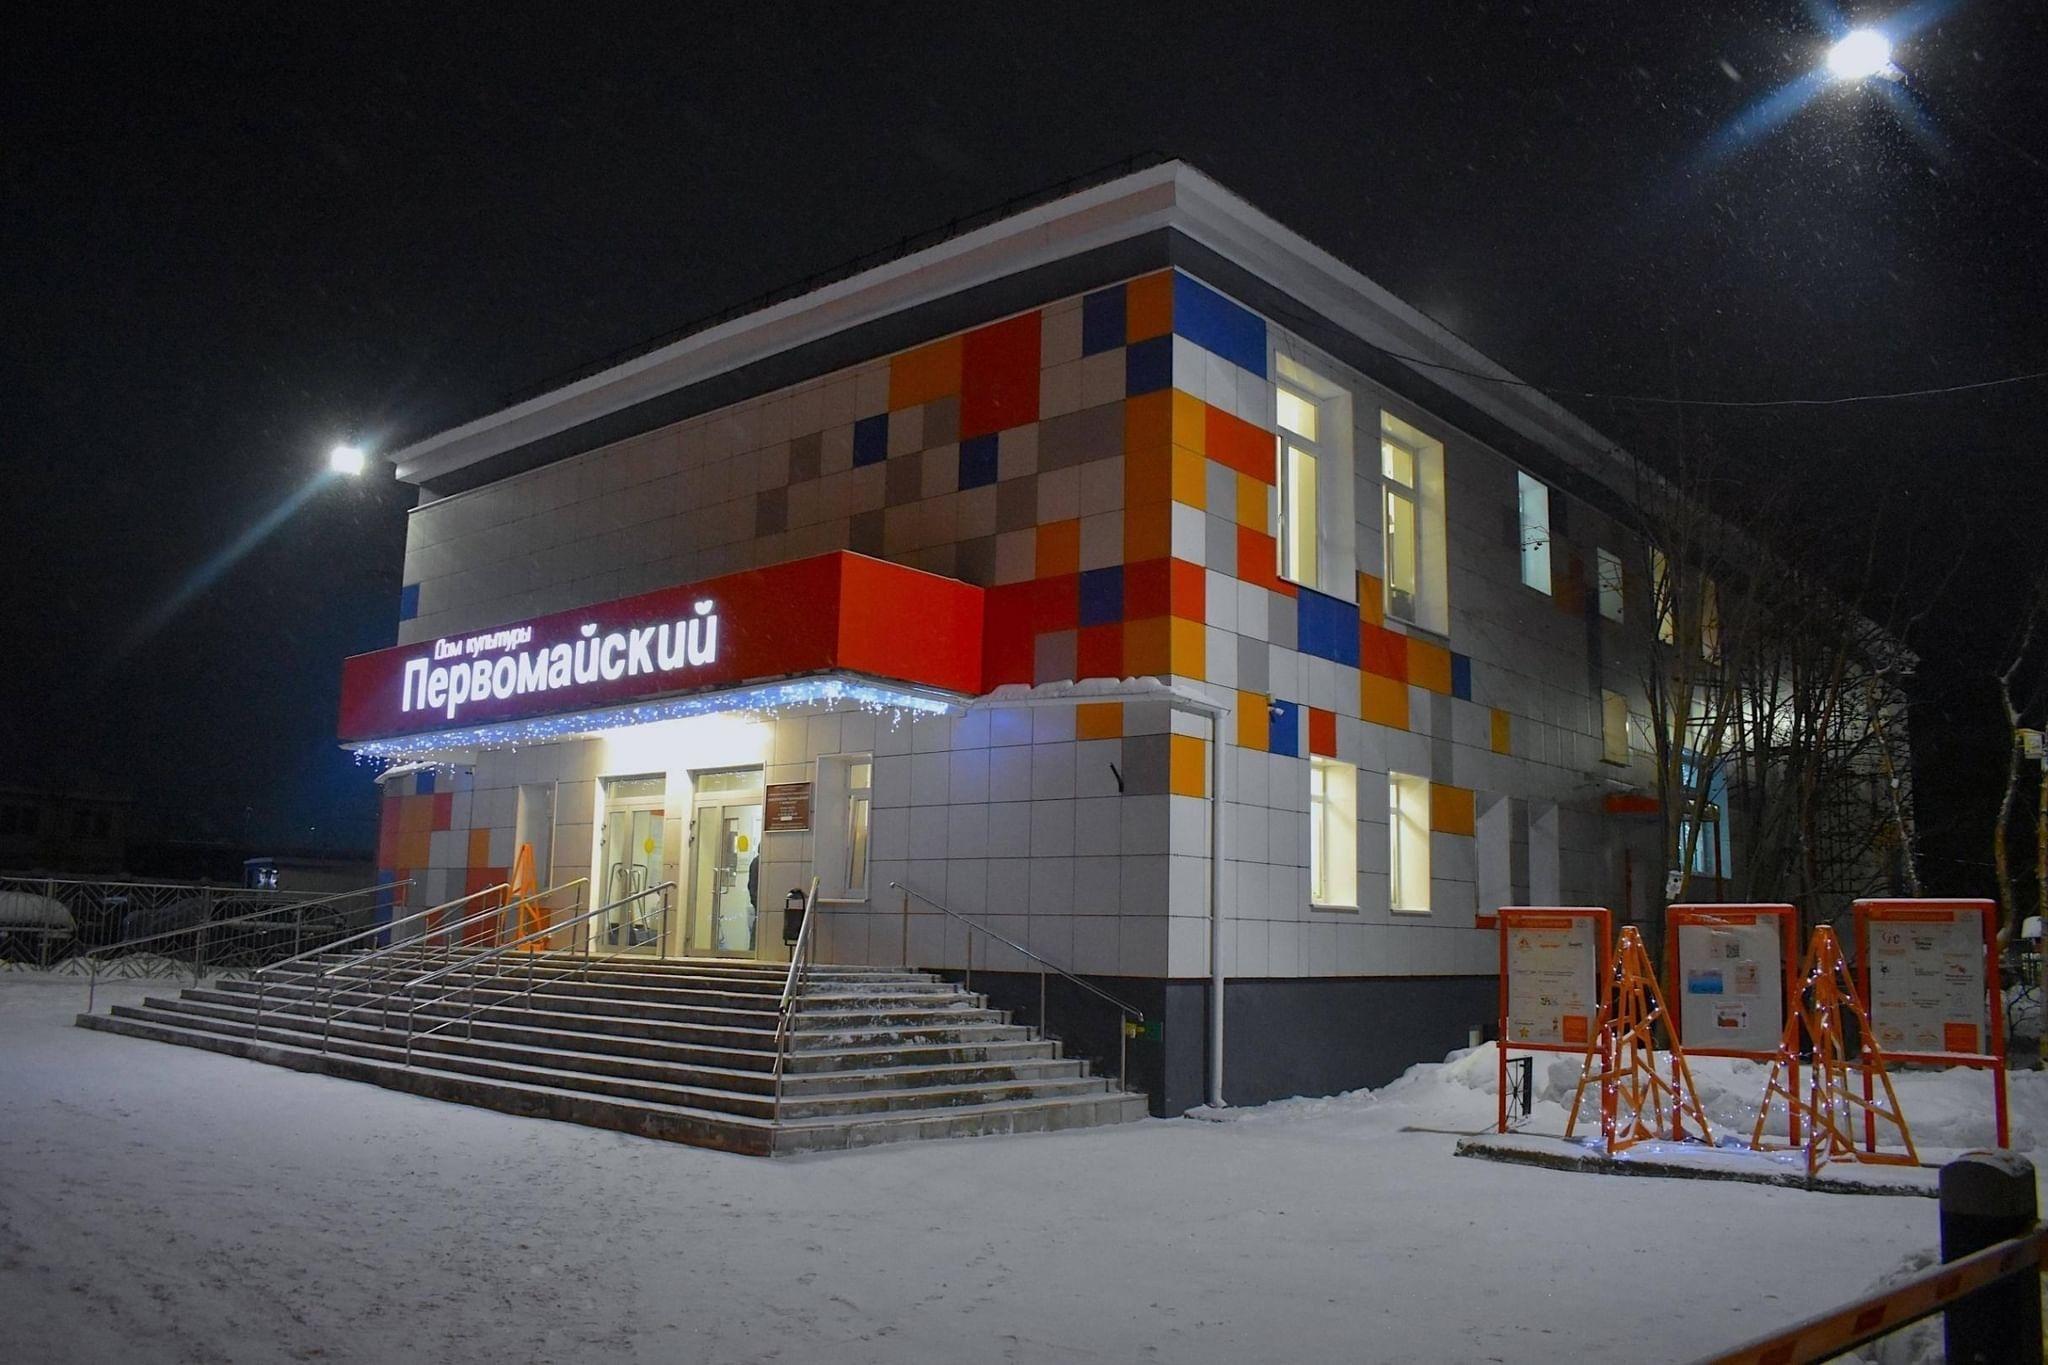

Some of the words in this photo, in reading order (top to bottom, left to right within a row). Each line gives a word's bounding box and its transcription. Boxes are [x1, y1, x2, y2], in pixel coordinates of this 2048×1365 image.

[402, 600, 717, 719] Первомайский
[434, 638, 463, 660] Дом
[466, 626, 532, 658] культуры
